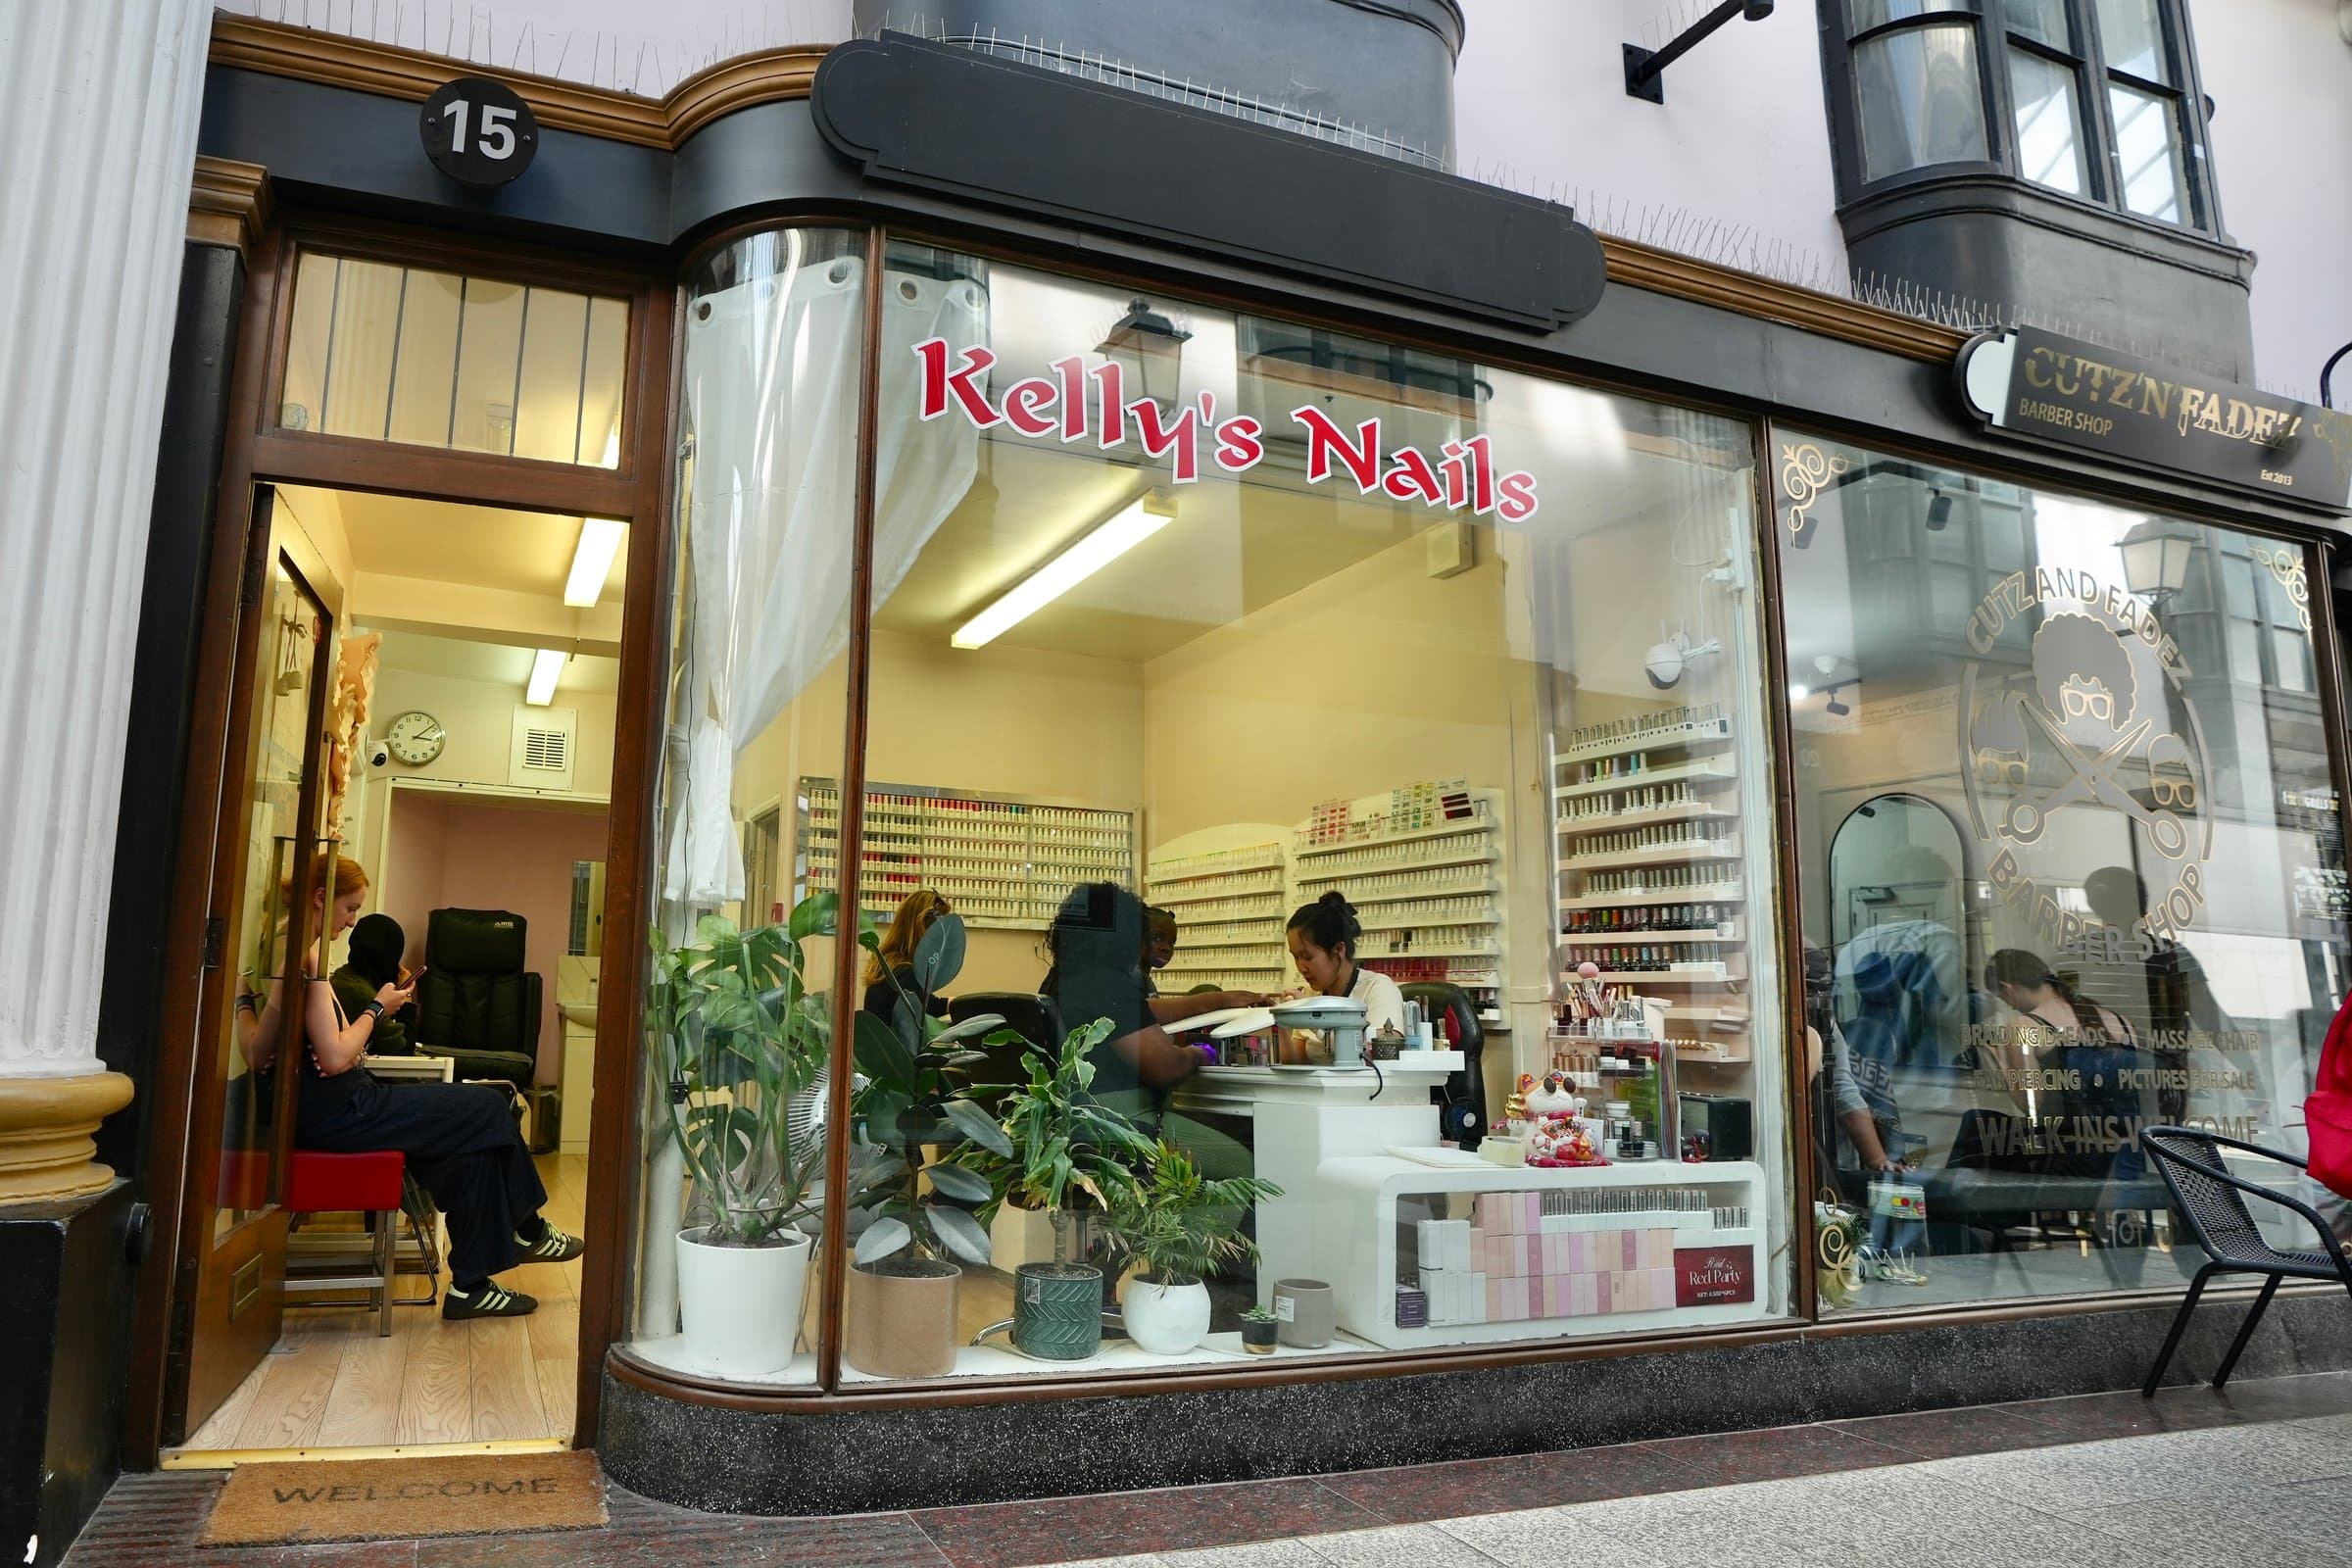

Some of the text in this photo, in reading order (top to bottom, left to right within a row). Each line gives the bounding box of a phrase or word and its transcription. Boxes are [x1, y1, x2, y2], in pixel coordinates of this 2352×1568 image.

[444, 100, 516, 160] 15
[909, 337, 1538, 522] Kelly's Nails
[2019, 398, 2113, 436] BARBER SHOP
[2260, 469, 2292, 486] Est 2013
[1966, 566, 2193, 691] CUTZ AND FADEZ
[2132, 863, 2204, 961] SHOP
[2009, 1069, 2081, 1090] PIERCING
[2118, 1068, 2188, 1090] PICTURES
[2222, 1070, 2256, 1090] SALE
[1690, 1270, 1741, 1285] Red Party
[272, 1478, 561, 1503] WELCOME
